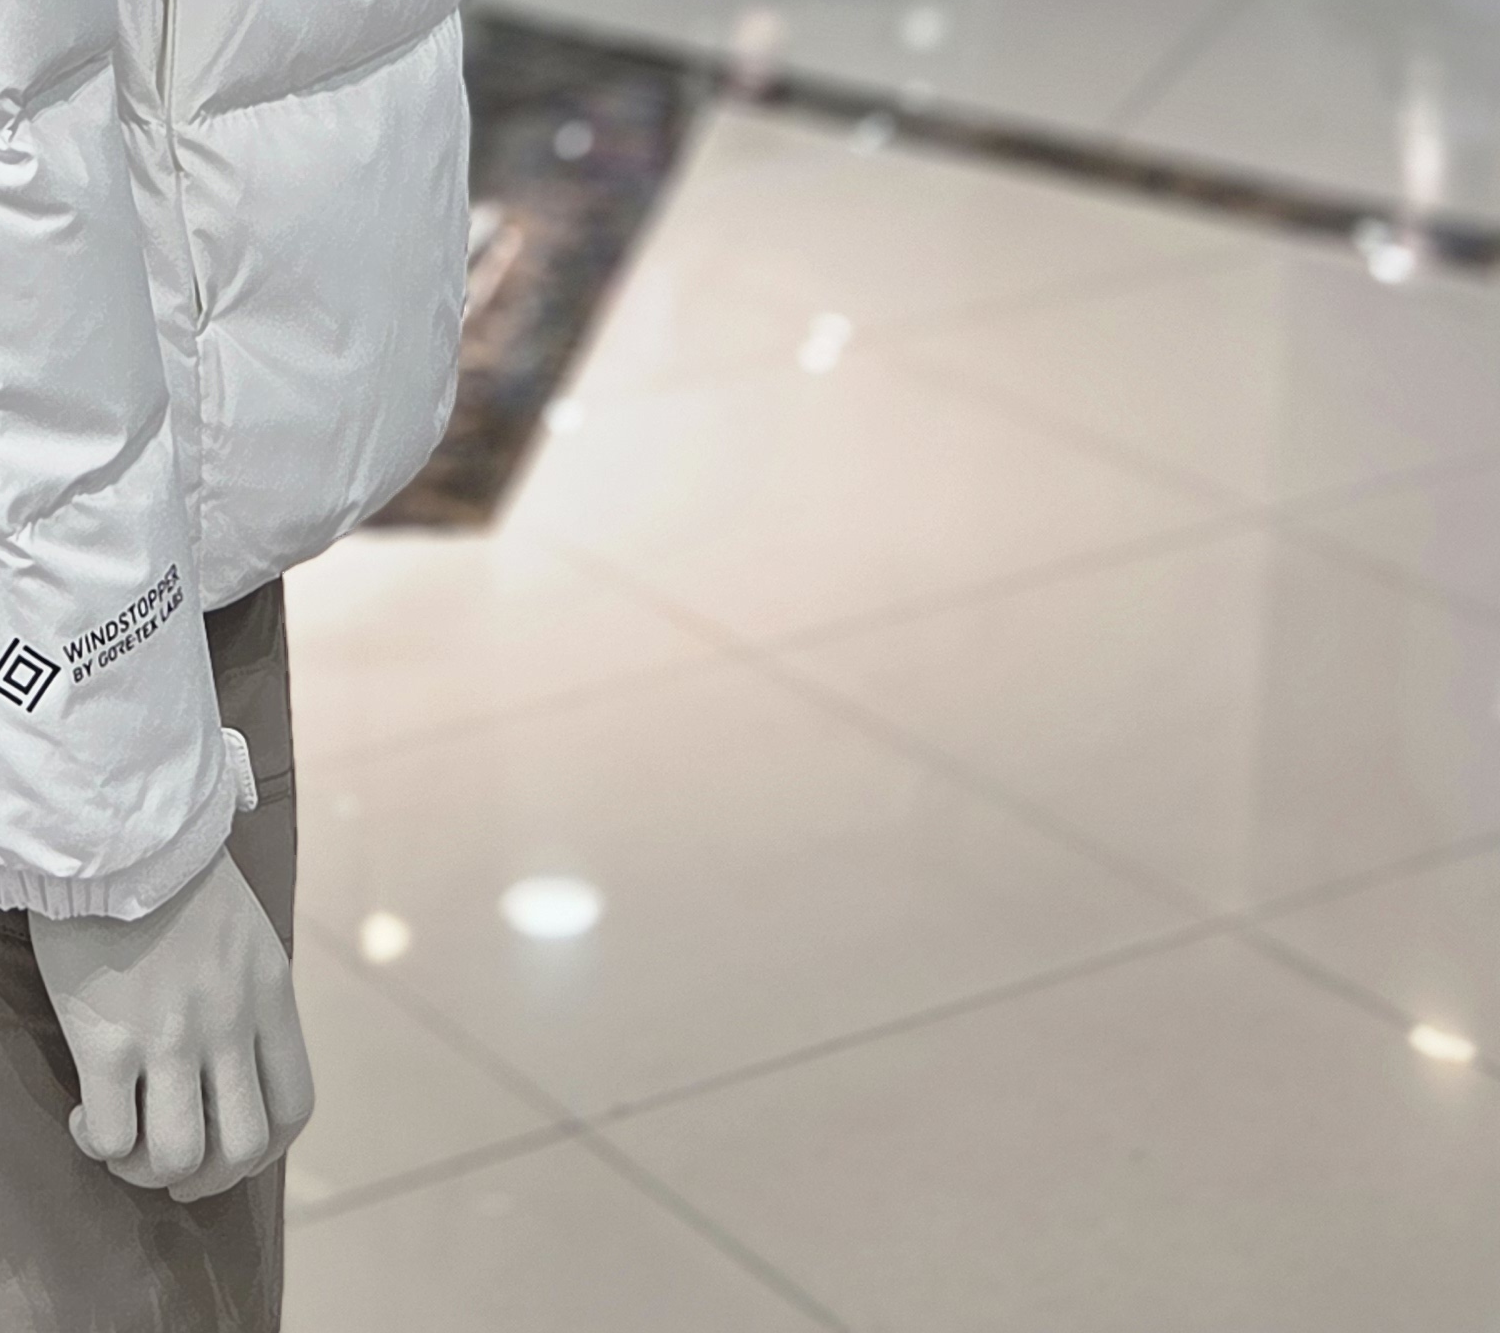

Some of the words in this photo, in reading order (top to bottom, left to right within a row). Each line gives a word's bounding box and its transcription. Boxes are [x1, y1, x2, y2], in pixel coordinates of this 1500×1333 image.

[63, 563, 180, 664] WINDSTOPPER
[72, 660, 94, 683] BY
[98, 616, 159, 668] GORE-TEX
